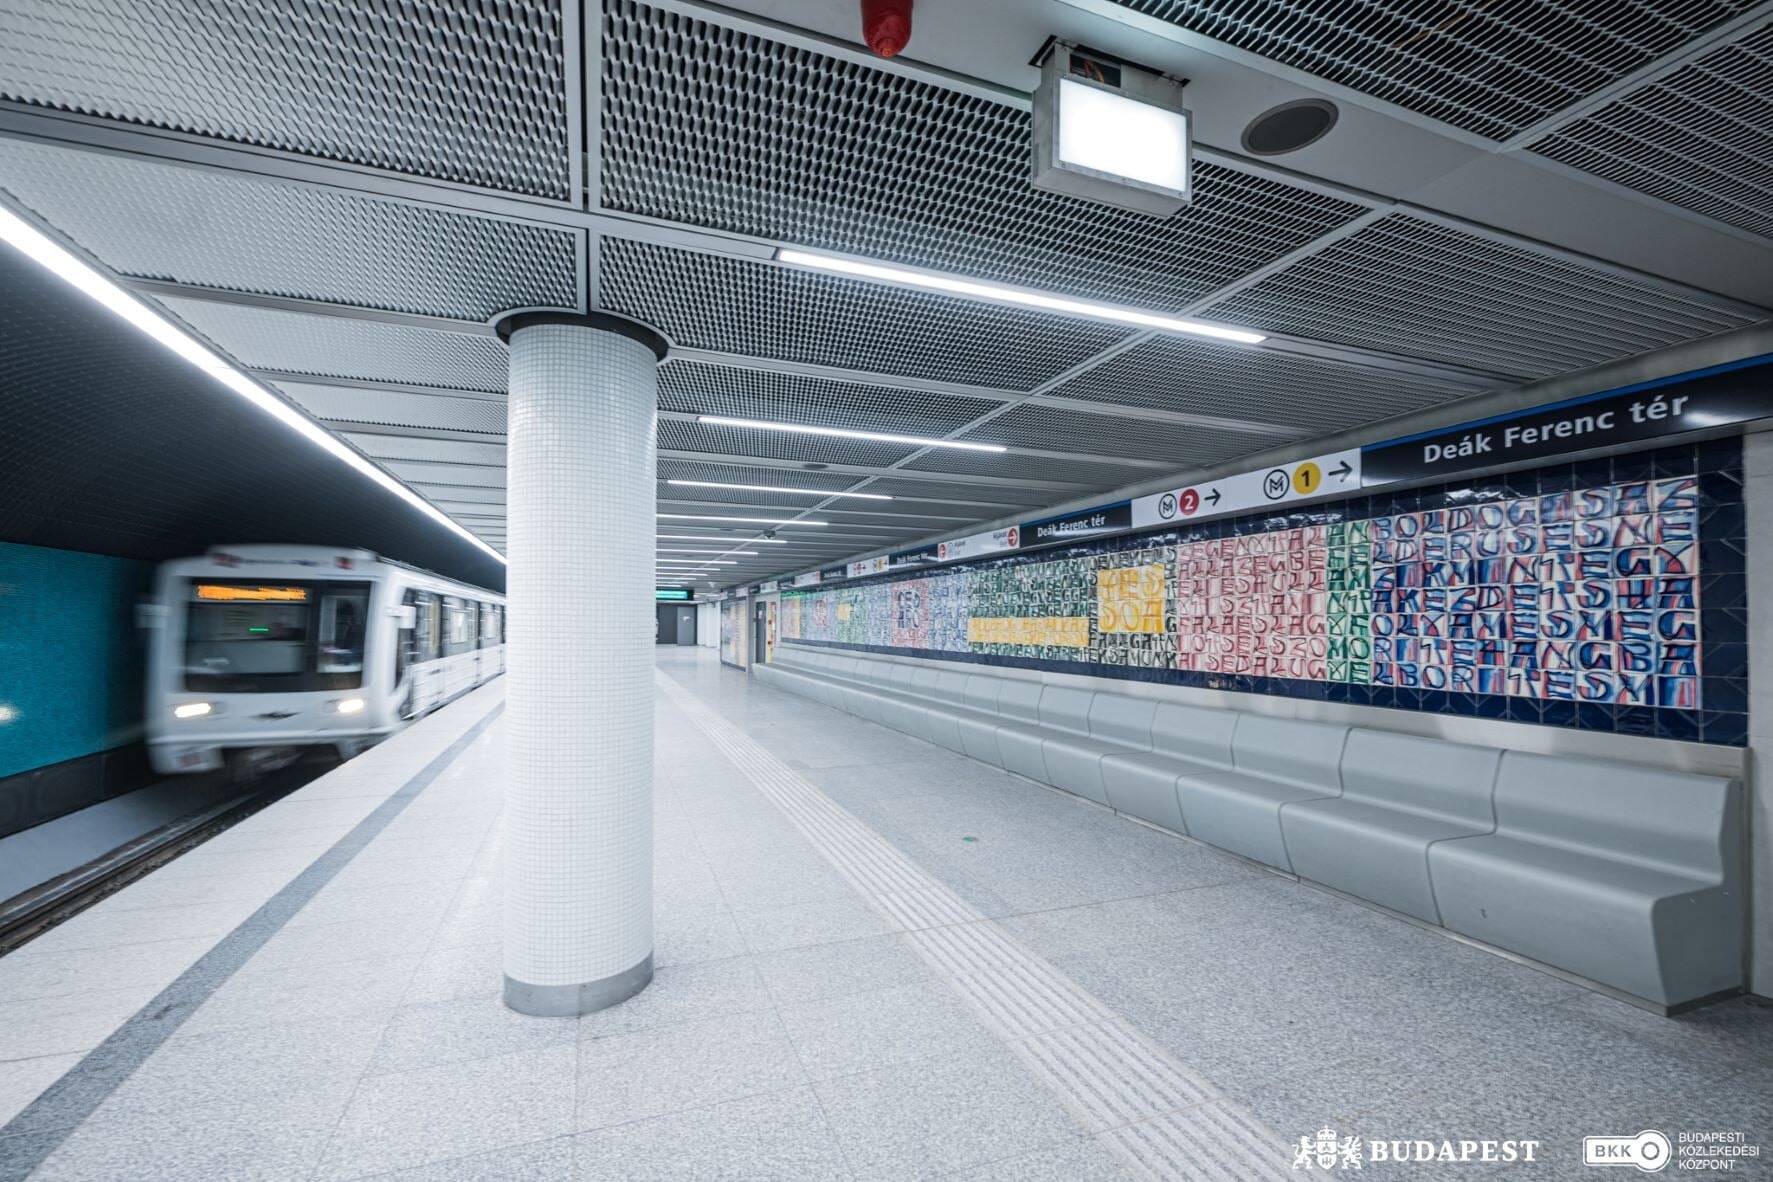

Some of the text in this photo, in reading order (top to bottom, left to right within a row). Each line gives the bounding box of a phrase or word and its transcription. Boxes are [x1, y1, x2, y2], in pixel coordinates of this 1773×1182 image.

[1423, 395, 1689, 463] Deák Ferenc tér
[1301, 470, 1310, 487] 1
[1184, 495, 1195, 510] 2
[1037, 514, 1106, 537] Deák Ferenc tér
